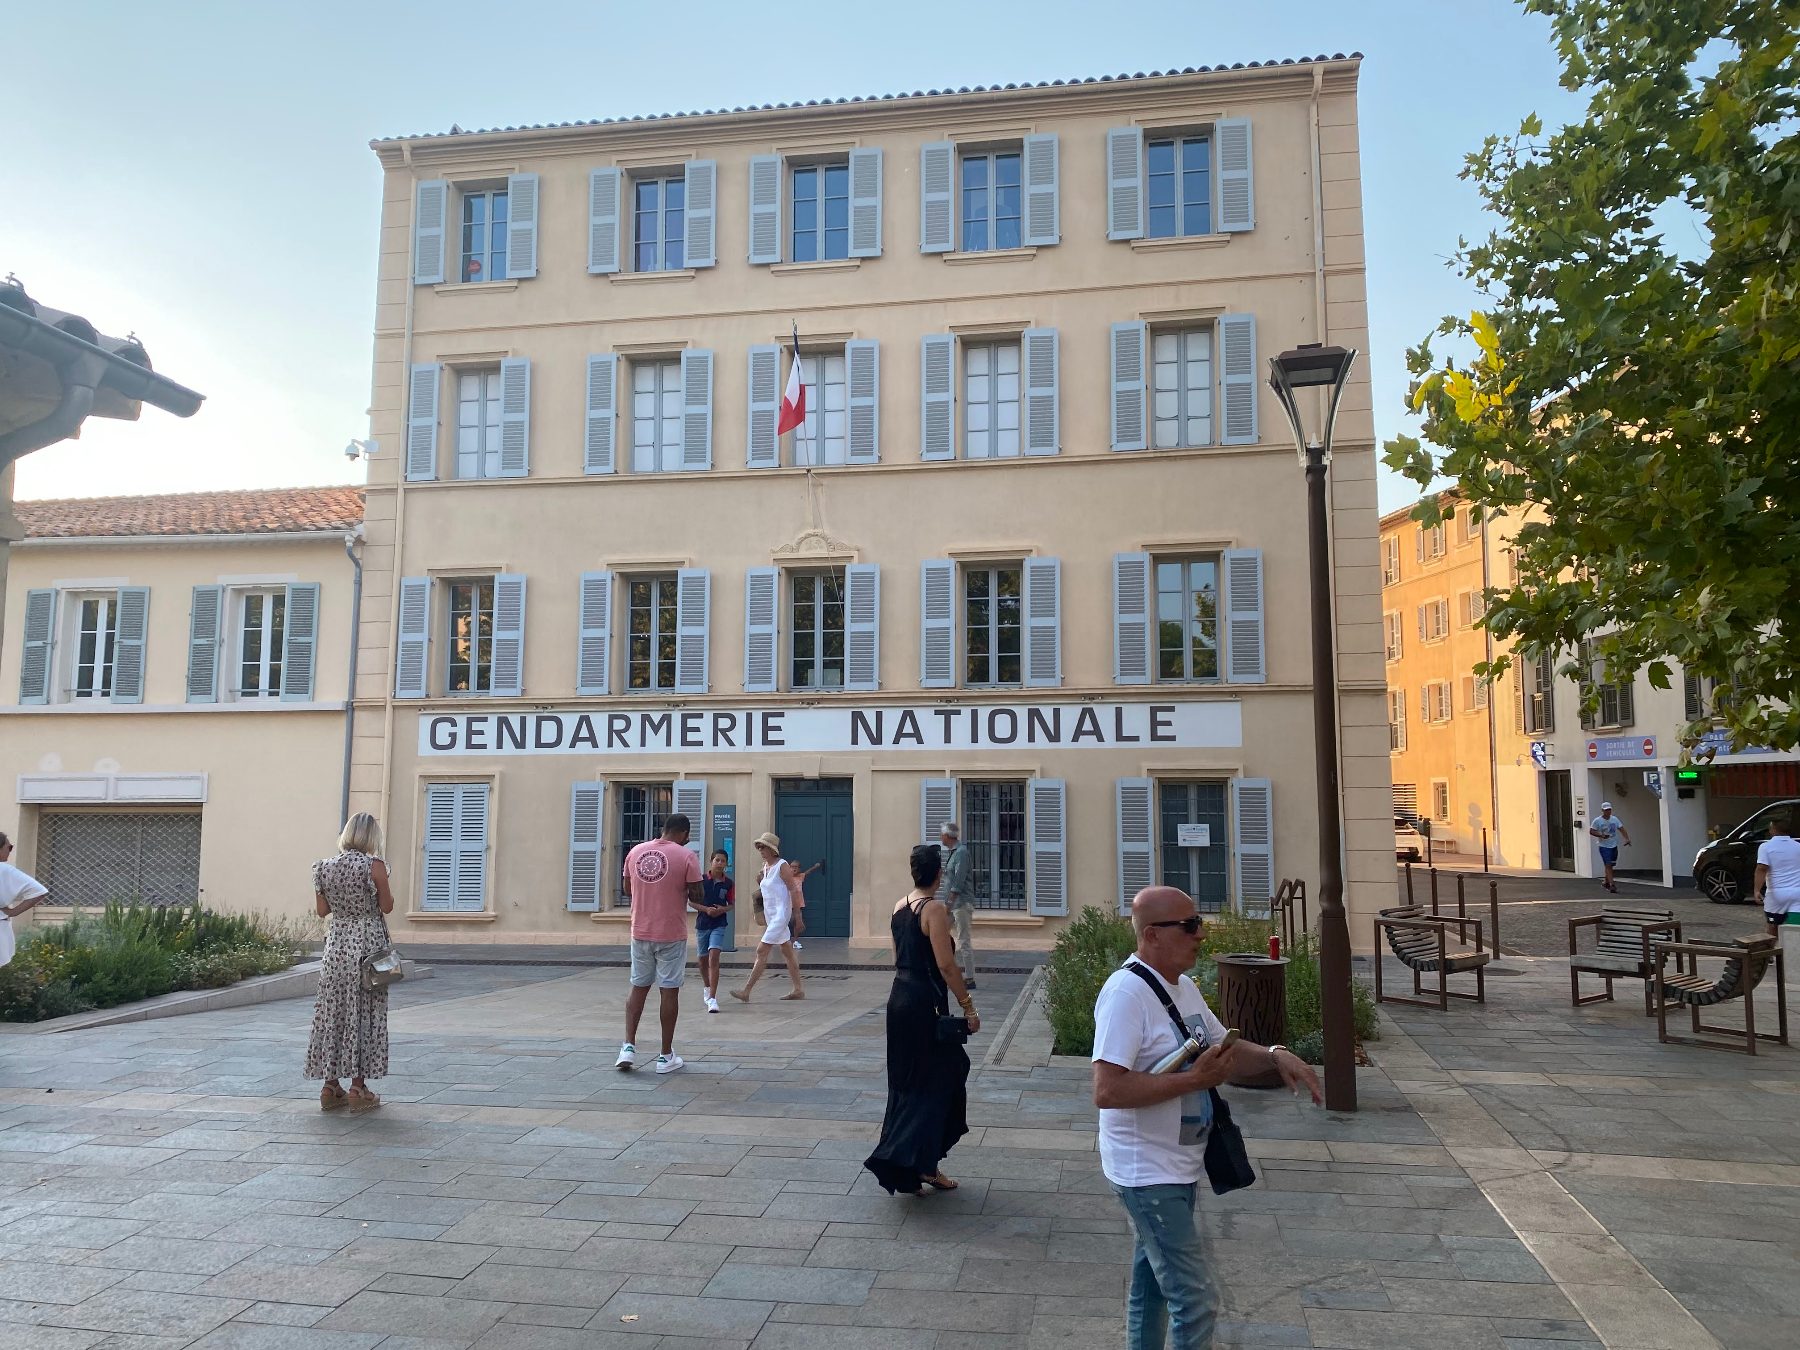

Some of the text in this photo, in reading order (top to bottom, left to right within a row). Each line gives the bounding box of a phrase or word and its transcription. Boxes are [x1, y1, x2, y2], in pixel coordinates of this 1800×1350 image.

[430, 706, 1176, 750] GENDARMERIE NATIONALE
[1606, 741, 1626, 750] SORTIE
[1649, 773, 1658, 784] P
